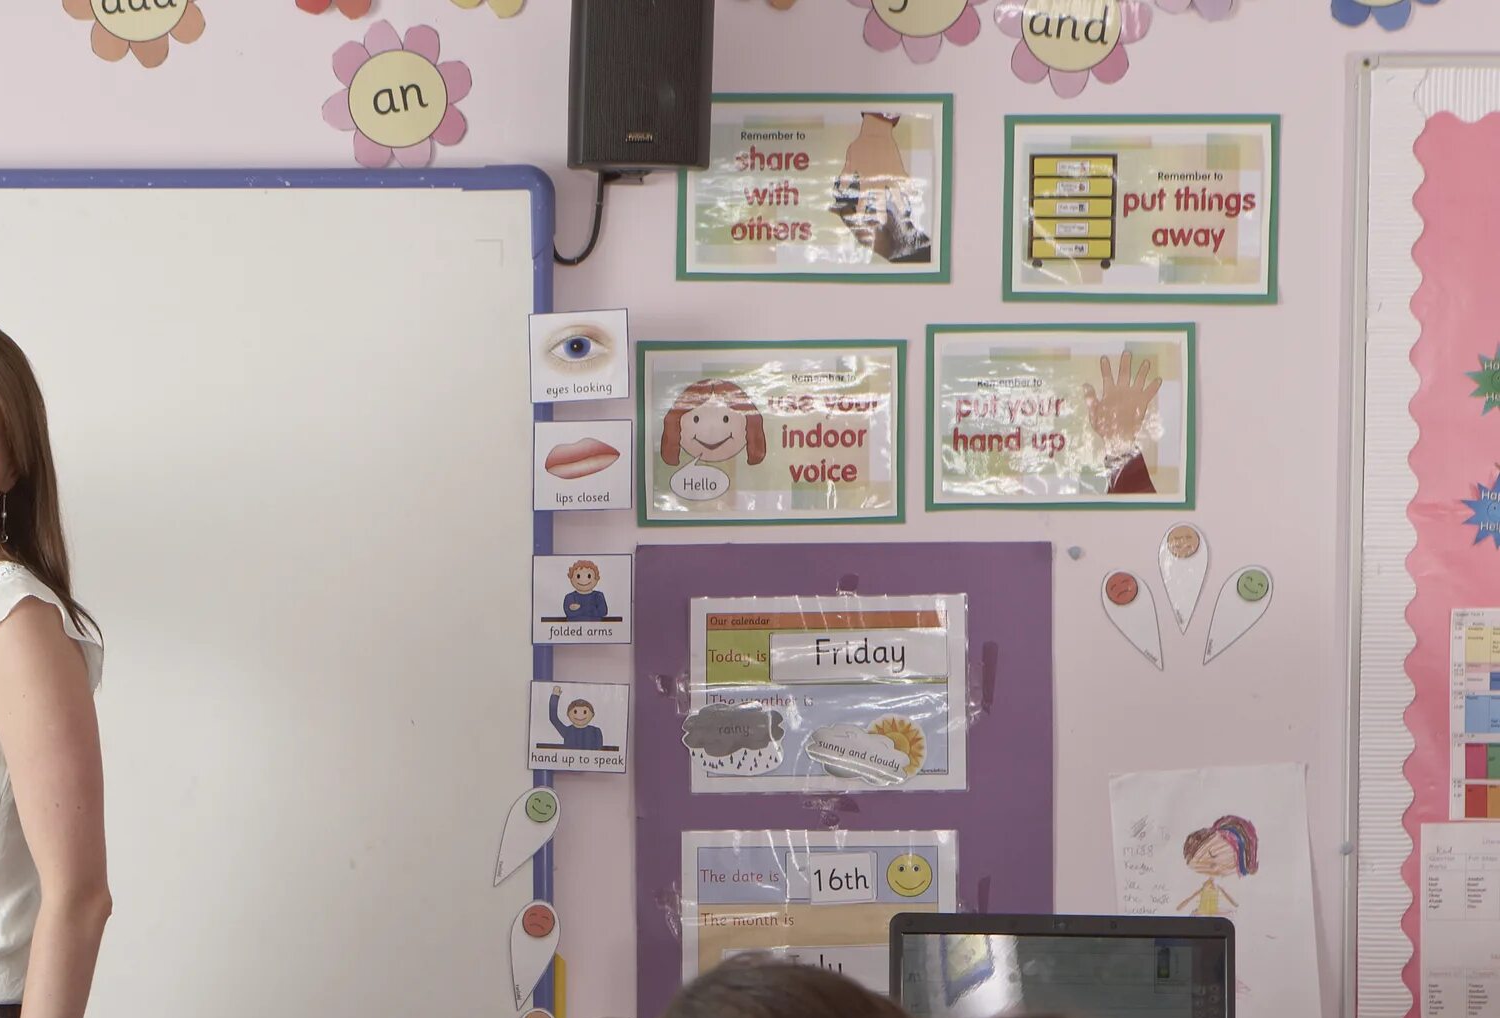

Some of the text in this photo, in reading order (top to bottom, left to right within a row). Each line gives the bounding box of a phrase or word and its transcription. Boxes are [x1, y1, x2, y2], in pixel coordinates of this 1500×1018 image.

[1029, 6, 1108, 45] and
[373, 79, 428, 117] an
[741, 131, 806, 140] Remember to
[735, 145, 810, 172] share
[1157, 171, 1223, 181] Remember to
[744, 181, 799, 206] with
[1123, 186, 1256, 218] put things
[731, 216, 812, 241] others
[1152, 228, 1225, 252] away
[546, 383, 612, 398] eyes looking
[782, 423, 867, 449] indoor
[953, 427, 1065, 458] hand up
[789, 459, 857, 483] voice
[683, 478, 717, 491] Hello
[556, 492, 610, 506] lips closed
[710, 616, 770, 626] Our calendar
[548, 627, 613, 640] folded arms
[708, 637, 906, 673] Today is Friday
[718, 724, 750, 738] rainy
[531, 752, 624, 768] hand up to speak
[818, 739, 846, 755] sunny
[849, 747, 867, 760] and
[869, 754, 901, 771] cloudy
[700, 867, 870, 893] The date is 16th
[701, 913, 794, 926] The month is
